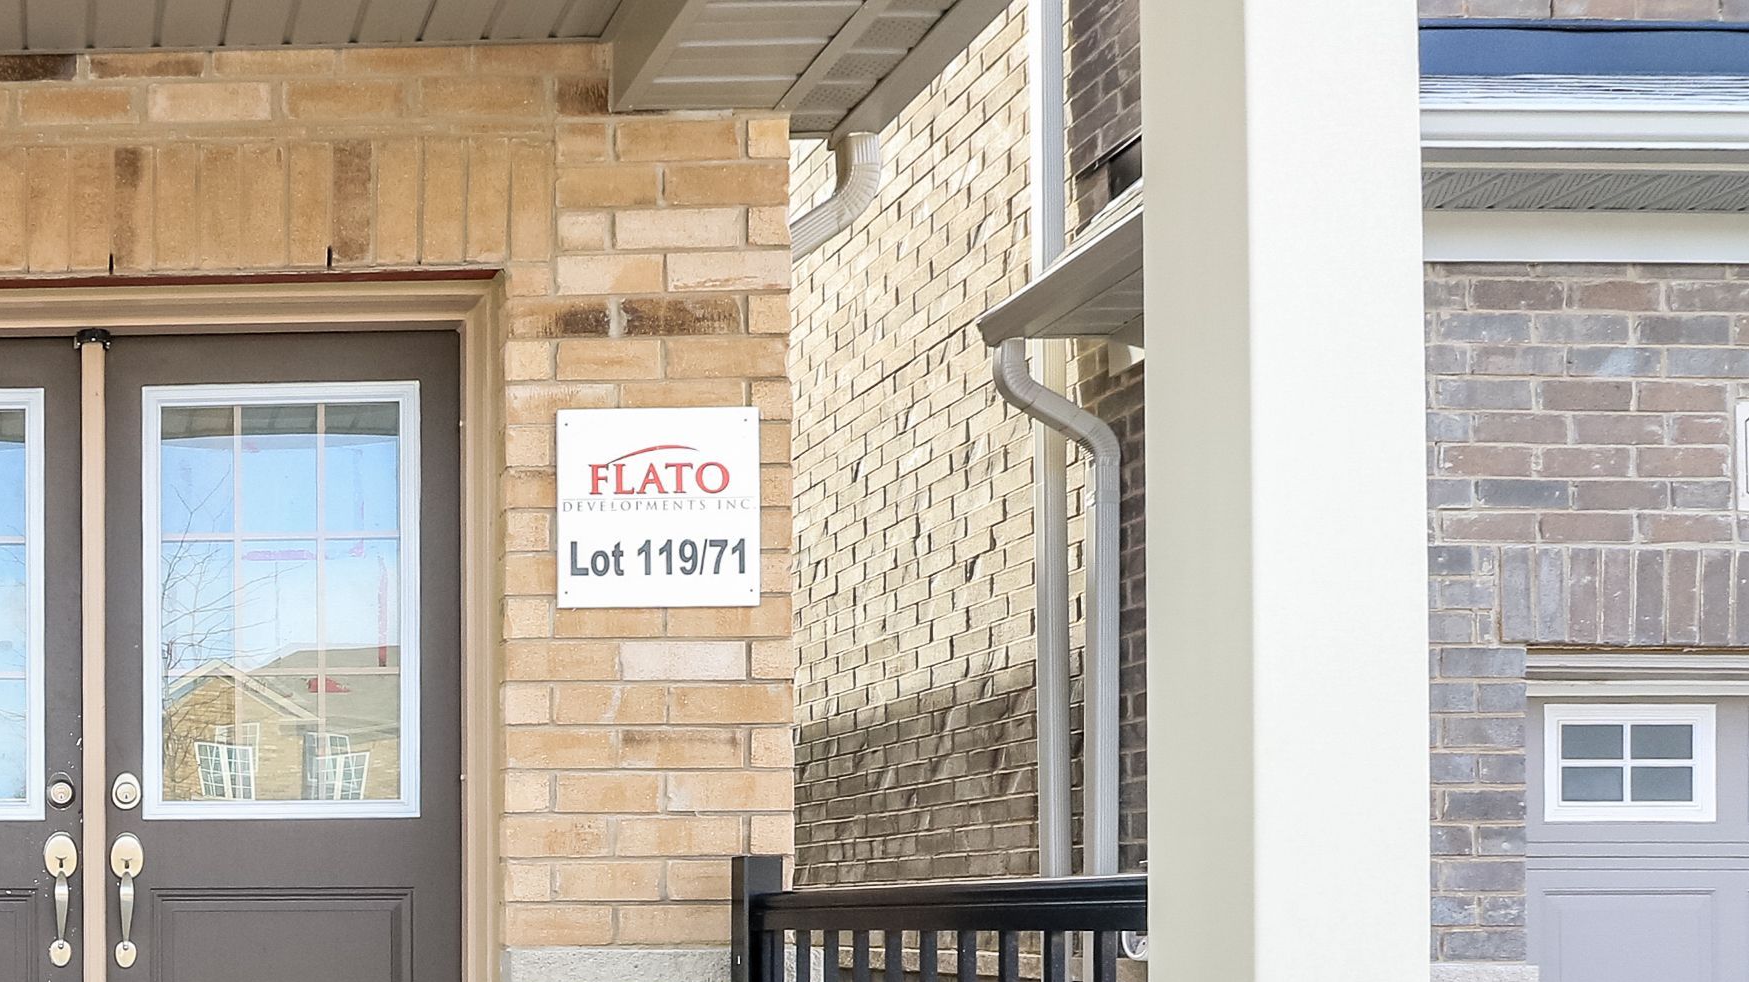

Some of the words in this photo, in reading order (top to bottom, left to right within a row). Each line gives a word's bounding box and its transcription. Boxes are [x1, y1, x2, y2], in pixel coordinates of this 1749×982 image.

[588, 461, 730, 495] FLATO
[562, 499, 706, 512] DEVELOPMENTS
[570, 540, 625, 577] Lot
[637, 537, 746, 576] 119/71
